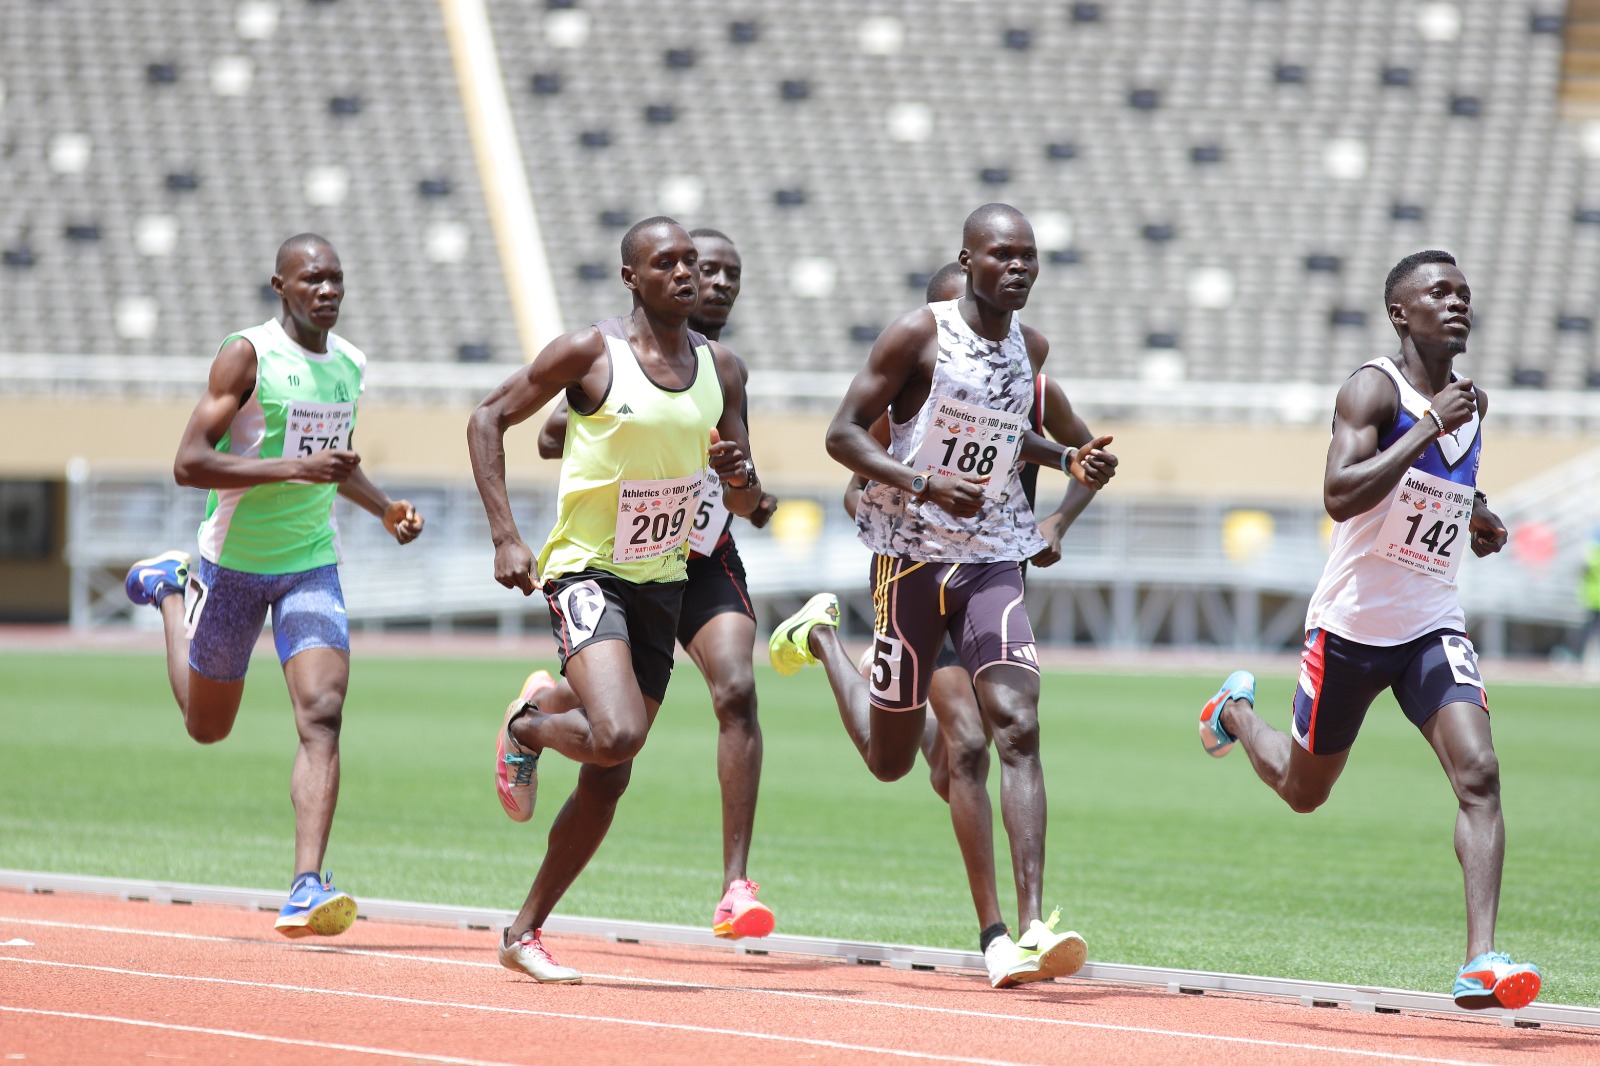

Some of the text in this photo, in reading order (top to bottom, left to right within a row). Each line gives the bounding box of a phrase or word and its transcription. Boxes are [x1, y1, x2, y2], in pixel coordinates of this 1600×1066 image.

[287, 374, 300, 386] 10
[292, 409, 324, 418] Athletics
[939, 405, 976, 422] Athletics
[1000, 422, 1018, 430] years
[941, 437, 998, 476] 188
[622, 488, 659, 498] Athletics
[686, 480, 702, 493] years
[1405, 478, 1444, 498] Athletics
[630, 508, 686, 544] 209
[1404, 514, 1458, 557] 142
[635, 544, 662, 553] NATIONAL
[1400, 547, 1430, 562] NATIONAL
[1434, 558, 1450, 568] TRIALS
[188, 578, 204, 624] 7
[872, 638, 892, 692] 5
[1448, 636, 1481, 682] 3
